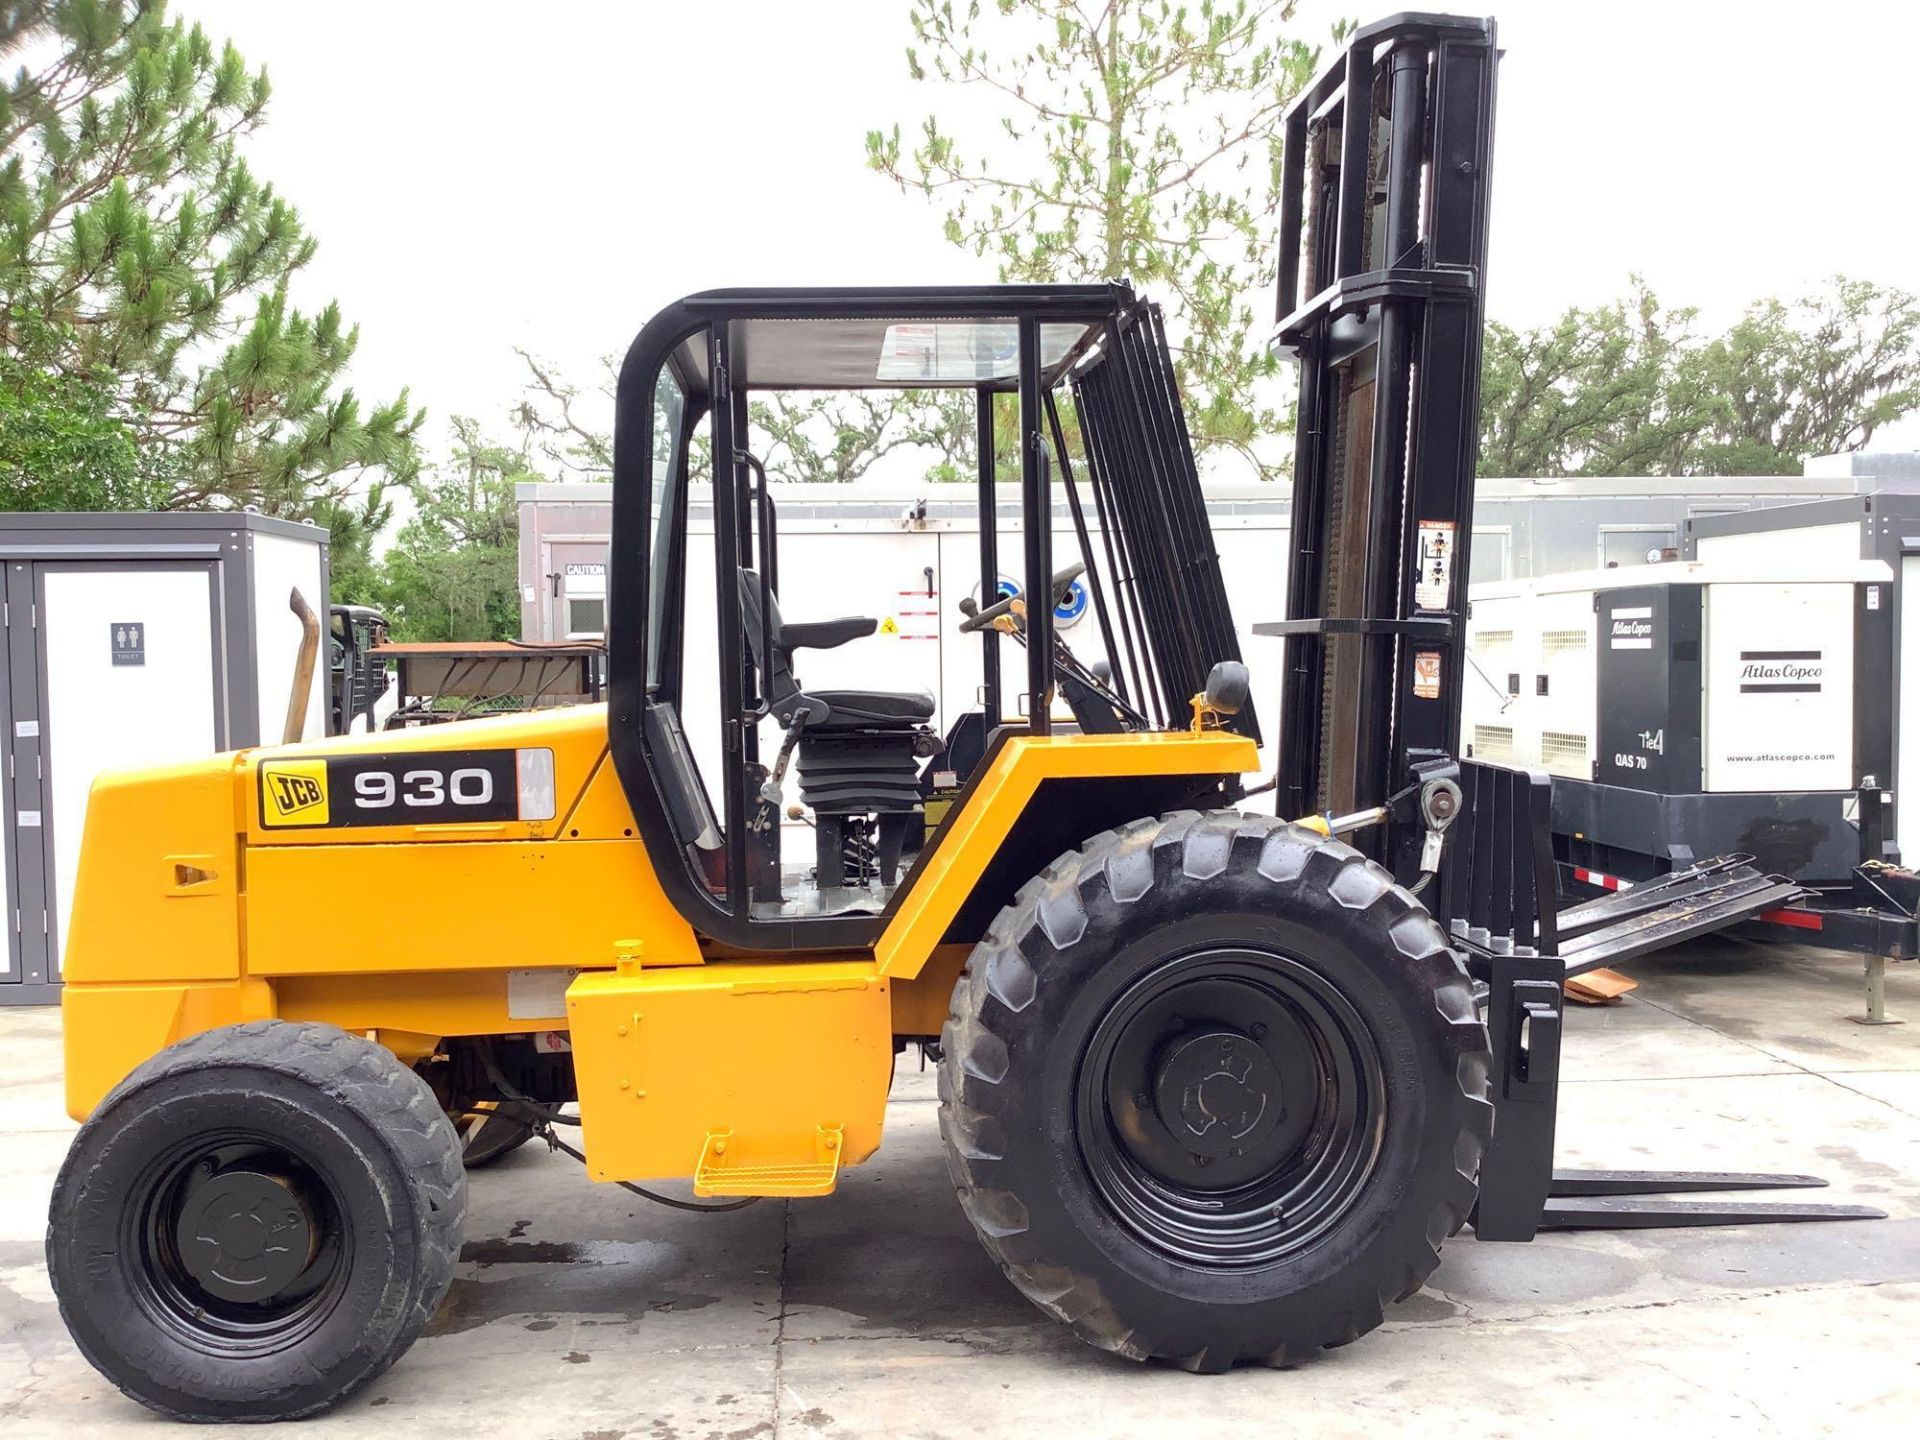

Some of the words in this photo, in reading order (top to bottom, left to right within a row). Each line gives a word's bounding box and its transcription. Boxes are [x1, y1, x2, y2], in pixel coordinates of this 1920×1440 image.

[567, 564, 605, 575] CAUTION
[1611, 621, 1632, 635] Atlas
[1632, 621, 1652, 637] Copco
[1740, 664, 1781, 679] Atlas
[1783, 664, 1823, 680] Copco
[1615, 753, 1634, 768] QAS
[1636, 756, 1647, 770] 70
[1727, 753, 1835, 762] www.atlascopco.com
[276, 777, 320, 811] JCB
[354, 768, 493, 808] 930
